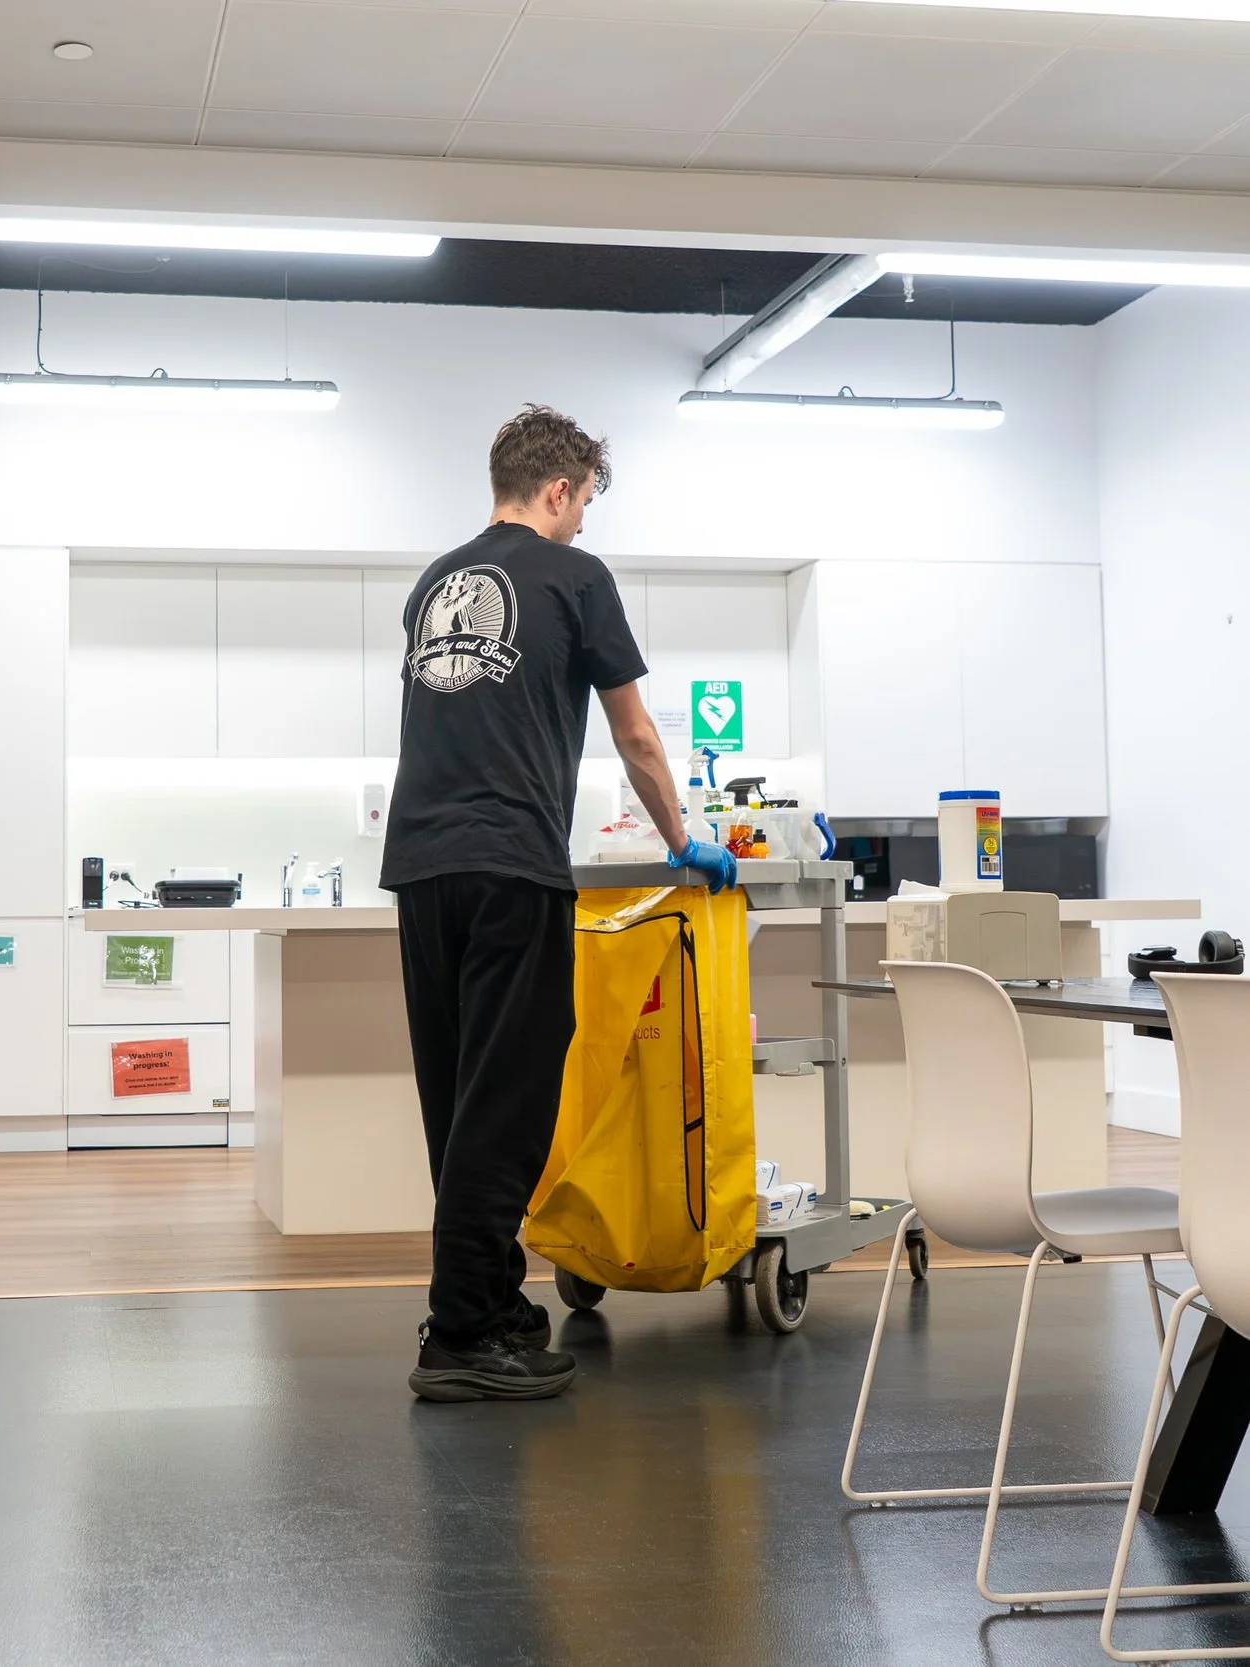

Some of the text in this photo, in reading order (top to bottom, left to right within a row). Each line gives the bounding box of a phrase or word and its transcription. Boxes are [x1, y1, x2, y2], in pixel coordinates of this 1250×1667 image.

[455, 639, 482, 651] and
[480, 640, 513, 667] Sons
[453, 664, 484, 686] CLEANING
[704, 682, 729, 695] AED
[128, 1051, 164, 1060] Washing
